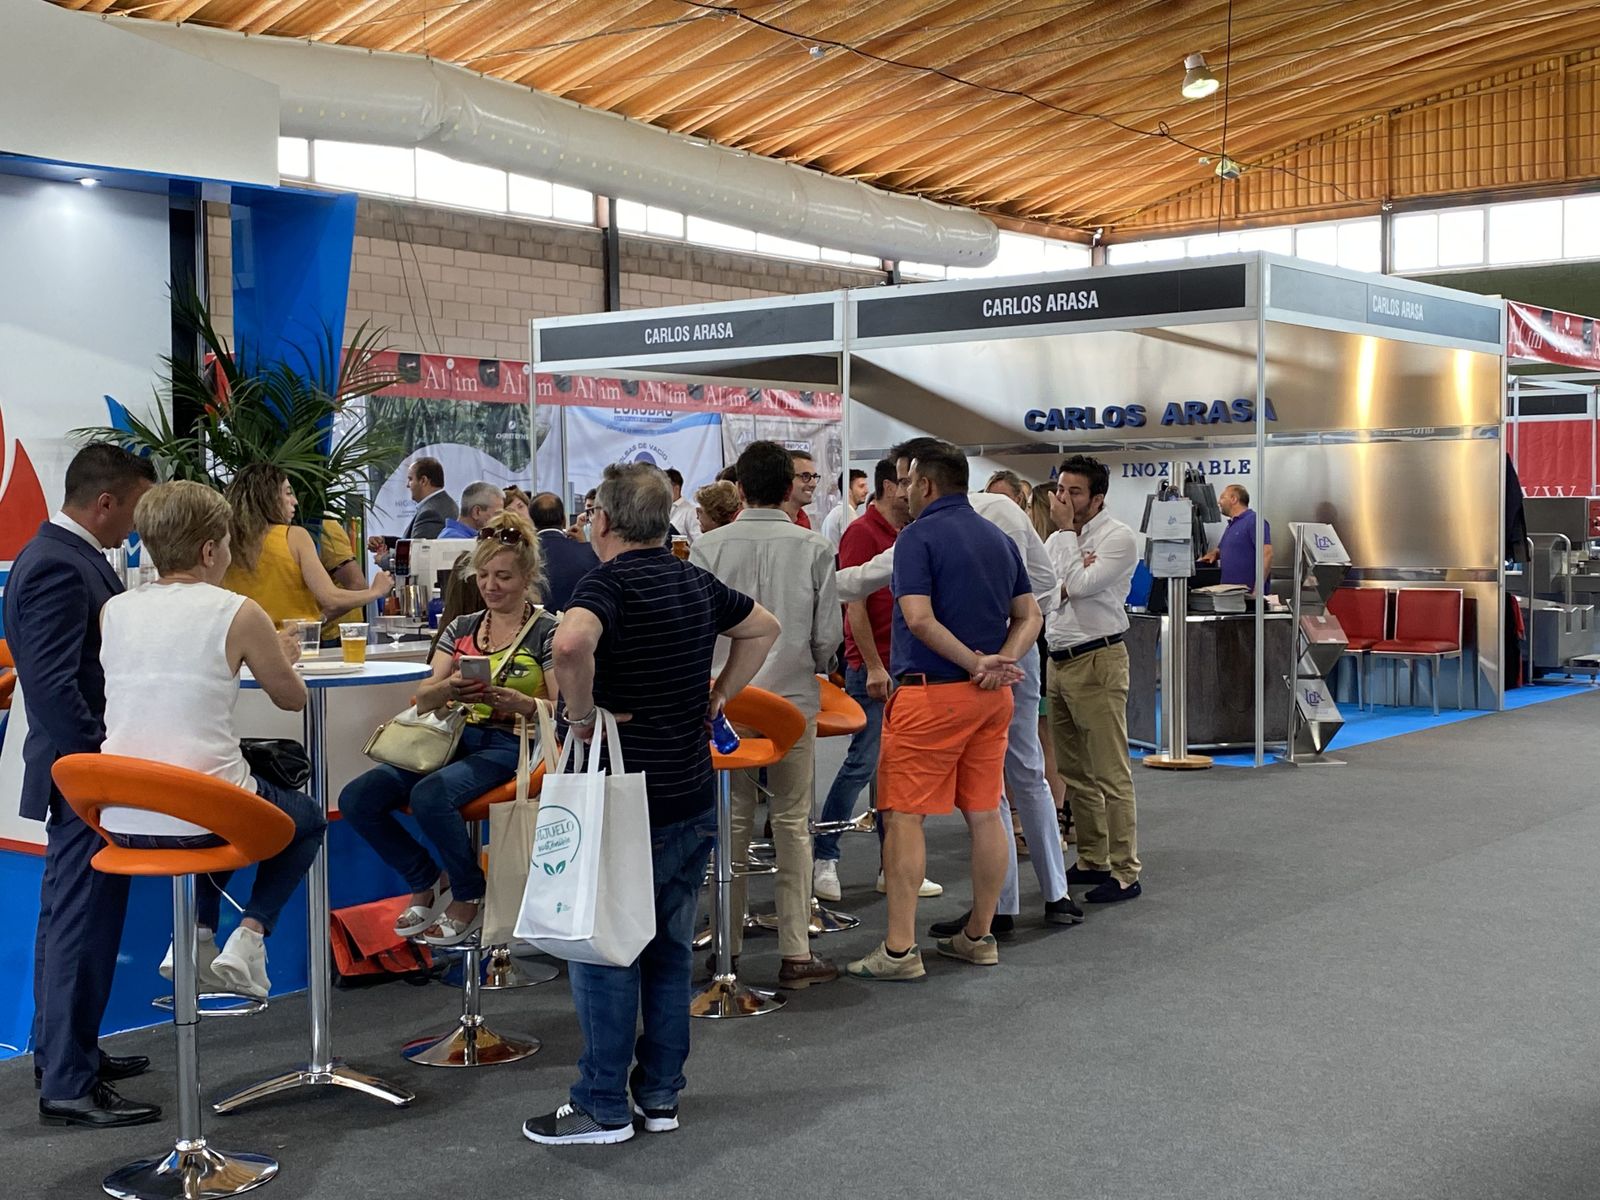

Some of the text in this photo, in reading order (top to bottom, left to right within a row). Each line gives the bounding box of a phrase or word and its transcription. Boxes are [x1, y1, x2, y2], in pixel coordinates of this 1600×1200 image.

[983, 289, 1099, 318] CARLOS ARASA
[1372, 294, 1424, 321] CARLOS ARASA
[645, 322, 734, 344] CARLOS ARASA
[1024, 398, 1278, 432] CARLOS ARASA
[1121, 459, 1251, 478] INOXABLE
